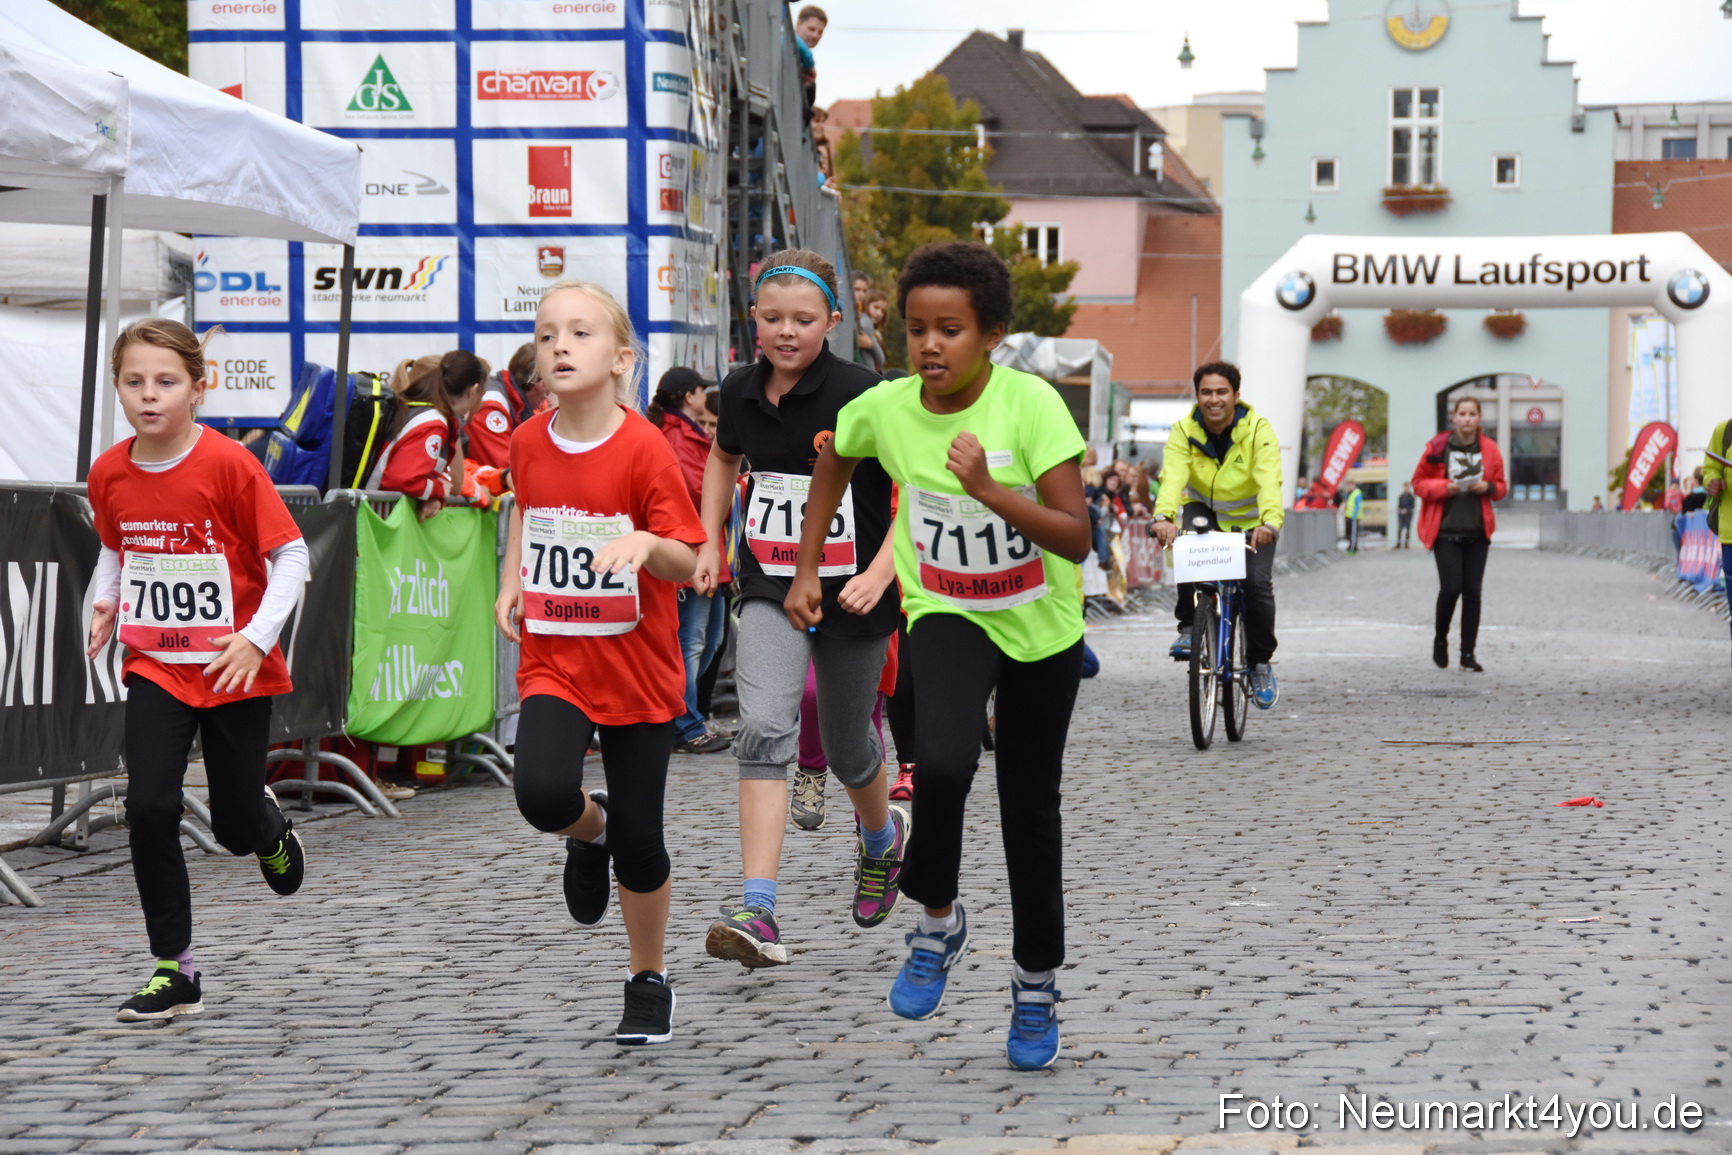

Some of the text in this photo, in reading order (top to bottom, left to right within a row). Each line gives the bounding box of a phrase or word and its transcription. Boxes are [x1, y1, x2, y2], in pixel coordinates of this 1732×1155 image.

[481, 69, 582, 94] charivari
[528, 184, 569, 205] Braun
[775, 266, 796, 274] PARTY
[1332, 253, 1441, 285] BMW
[1454, 253, 1651, 291] Laufsport
[220, 291, 281, 306] energie
[374, 292, 427, 302] neumarkt
[225, 359, 267, 374] CODE
[225, 376, 276, 390] CLINIC
[1322, 427, 1361, 486] REWE
[1628, 427, 1670, 489] REWE
[120, 519, 178, 532] eumarkter
[561, 520, 623, 536] BOCK
[923, 517, 1032, 567] 7115
[1189, 545, 1230, 554] Erste Frau
[770, 546, 826, 563] Anta
[1187, 556, 1233, 568] Jugendlauf
[160, 558, 219, 572] BOCK
[529, 541, 625, 590] 7032
[937, 573, 1025, 596] Lya-Marie
[130, 579, 223, 622] 7093
[544, 600, 601, 622] Sophie
[157, 632, 190, 648] Jule
